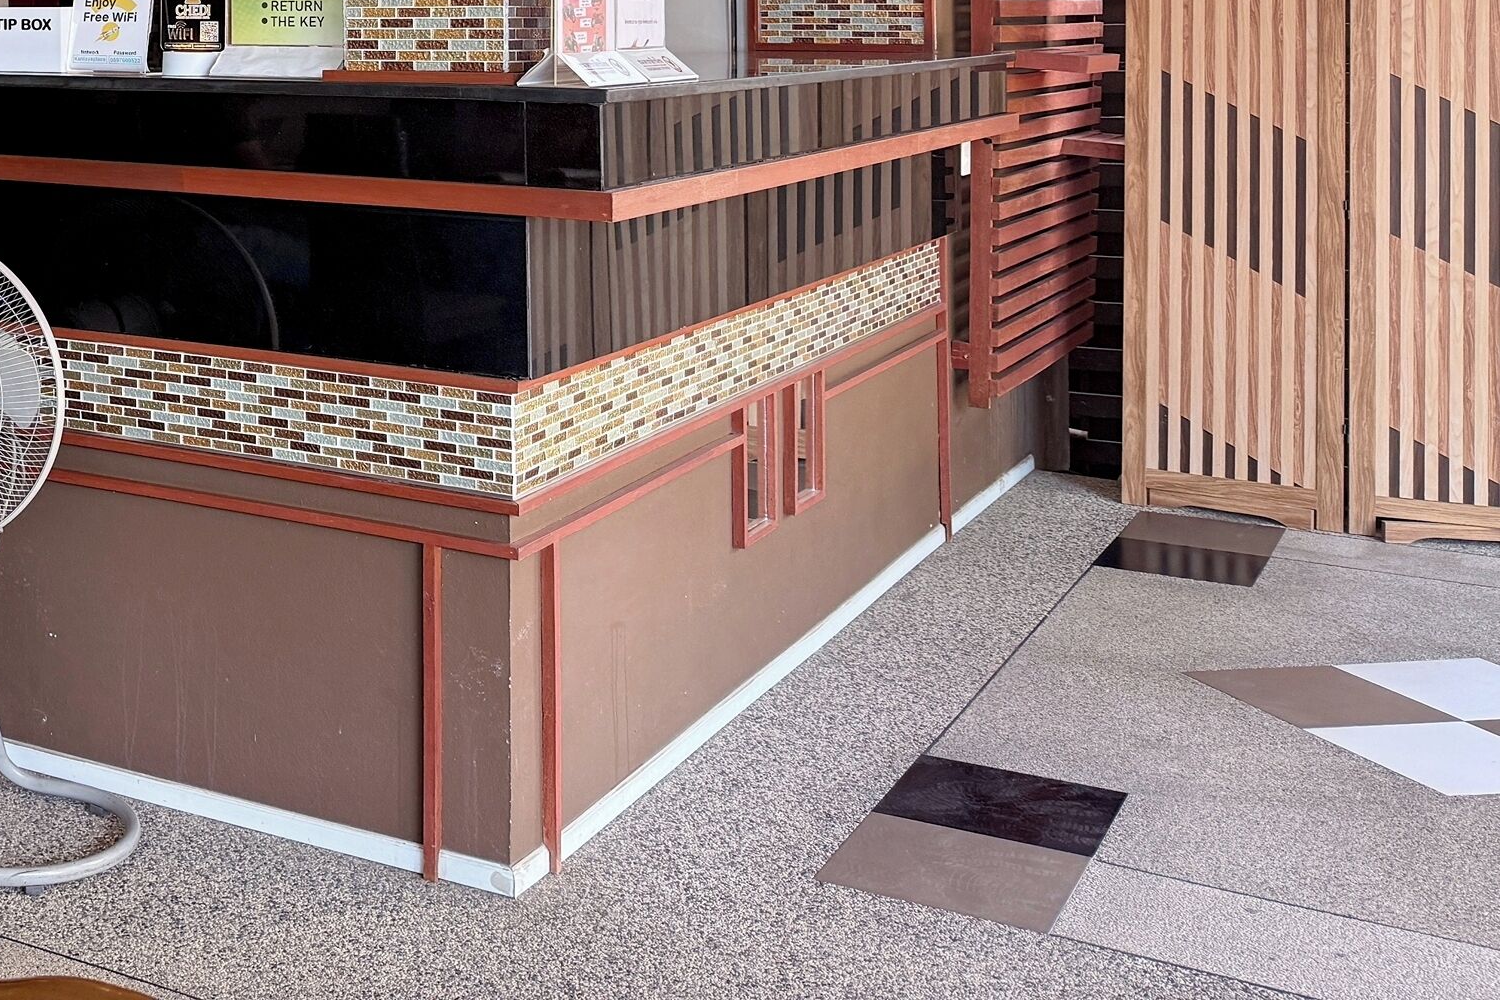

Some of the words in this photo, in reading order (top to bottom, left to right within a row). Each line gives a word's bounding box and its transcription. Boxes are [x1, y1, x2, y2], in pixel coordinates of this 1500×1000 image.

[175, 4, 211, 16] CHEDI
[271, 0, 323, 12] RETURN
[83, 12, 109, 22] Free
[112, 12, 137, 22] WiFi
[270, 16, 295, 27] THE
[300, 16, 325, 27] KEY
[21, 18, 52, 31] BOX
